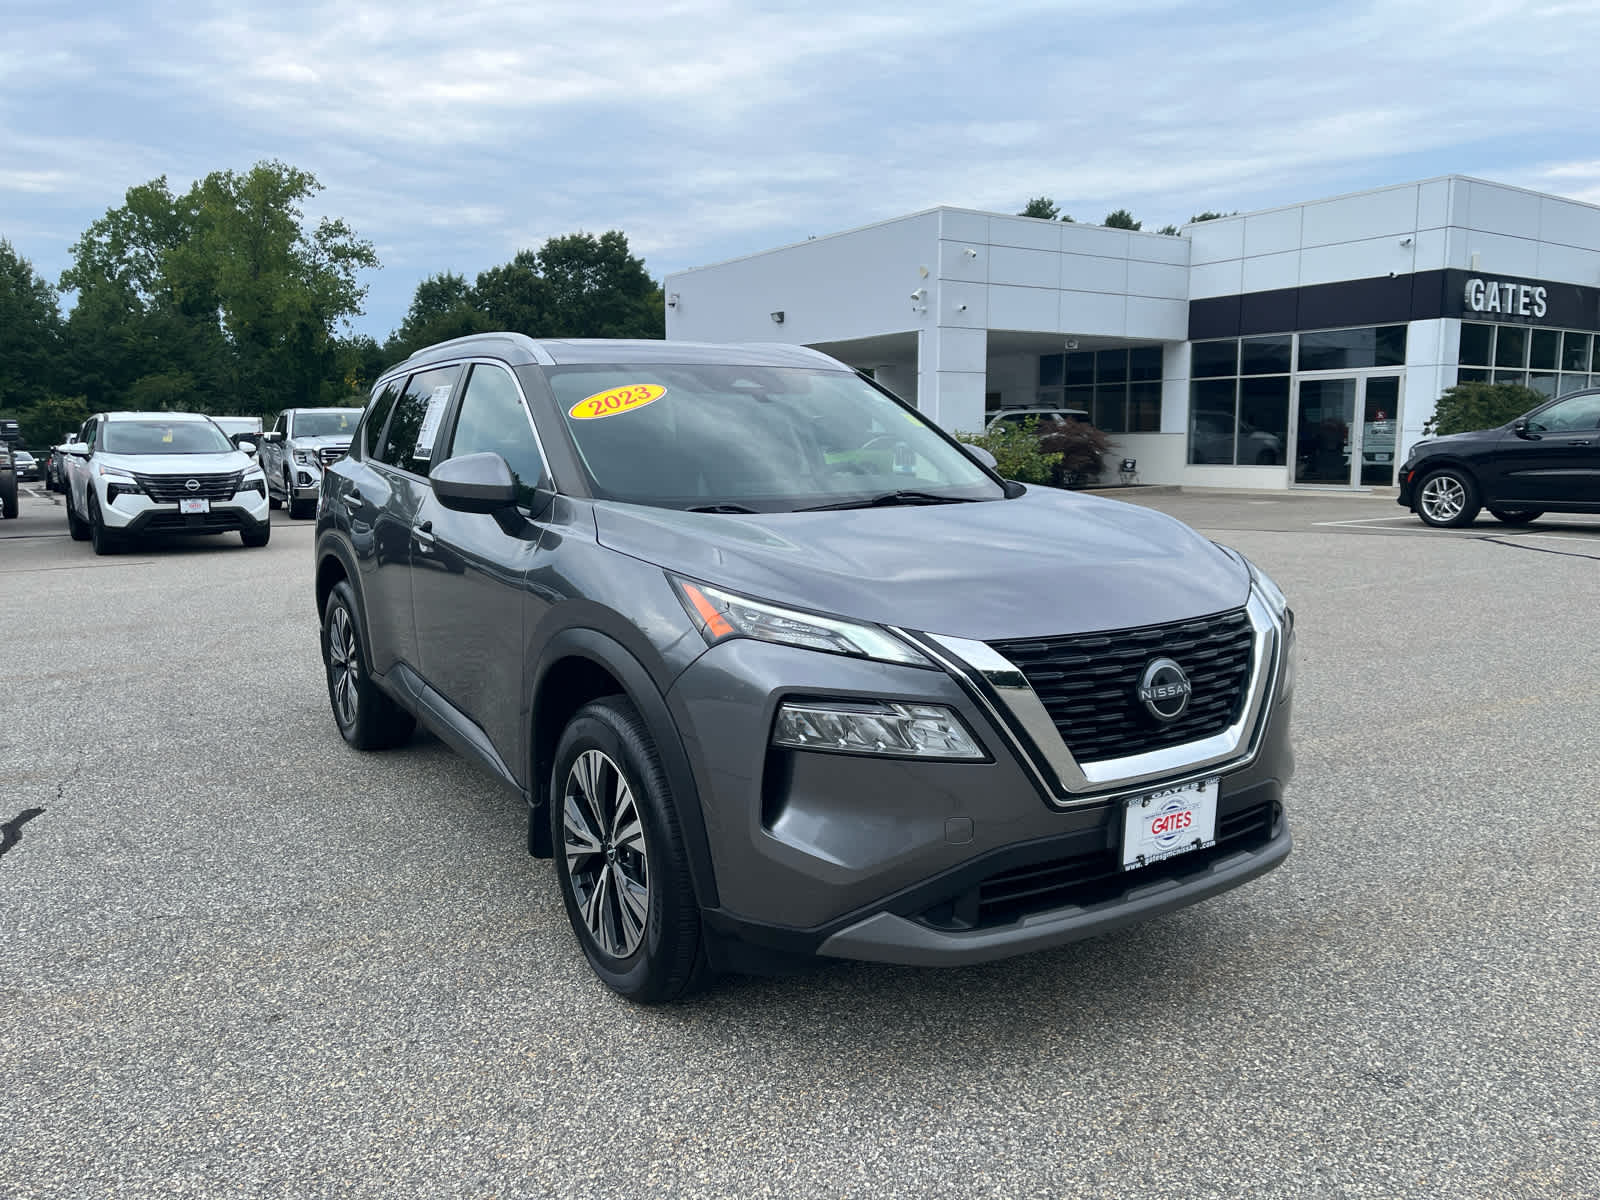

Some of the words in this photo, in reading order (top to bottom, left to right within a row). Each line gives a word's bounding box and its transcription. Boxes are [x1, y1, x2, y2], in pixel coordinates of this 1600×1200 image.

[1465, 278, 1547, 318] GATES
[588, 386, 652, 416] 2023
[1141, 678, 1192, 699] NISSAN
[1151, 810, 1192, 835] GATES
